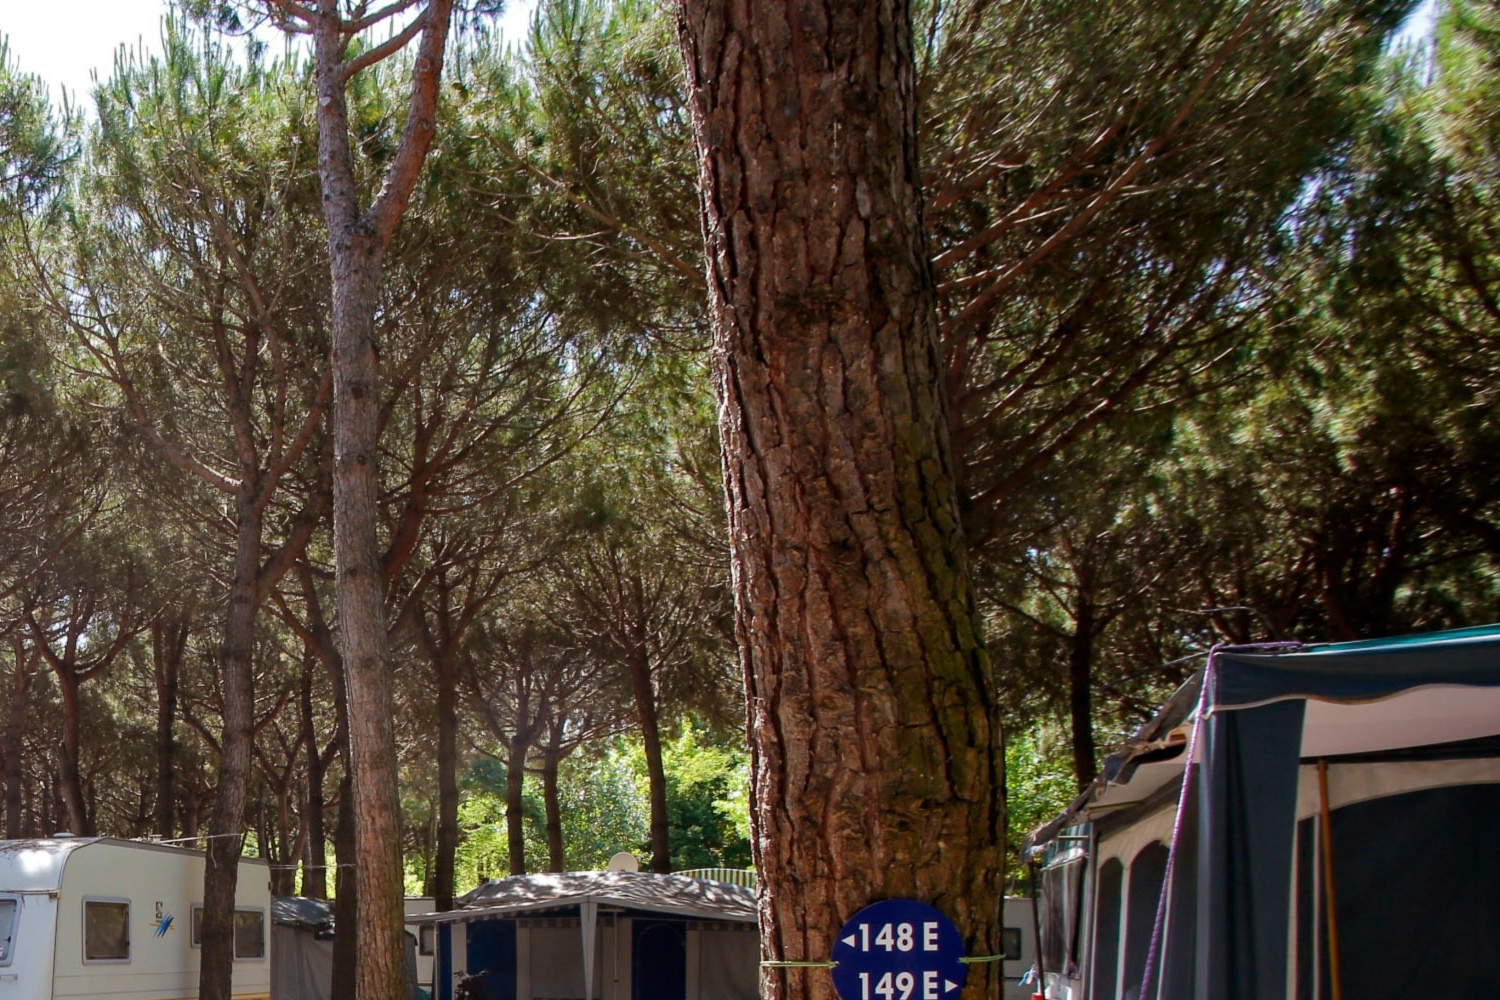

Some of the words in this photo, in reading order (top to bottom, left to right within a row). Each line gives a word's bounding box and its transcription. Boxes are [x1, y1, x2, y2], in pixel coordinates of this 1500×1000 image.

[859, 923, 914, 952] 148
[923, 922, 938, 951] E
[859, 972, 914, 1000] 149
[923, 971, 938, 1000] E
